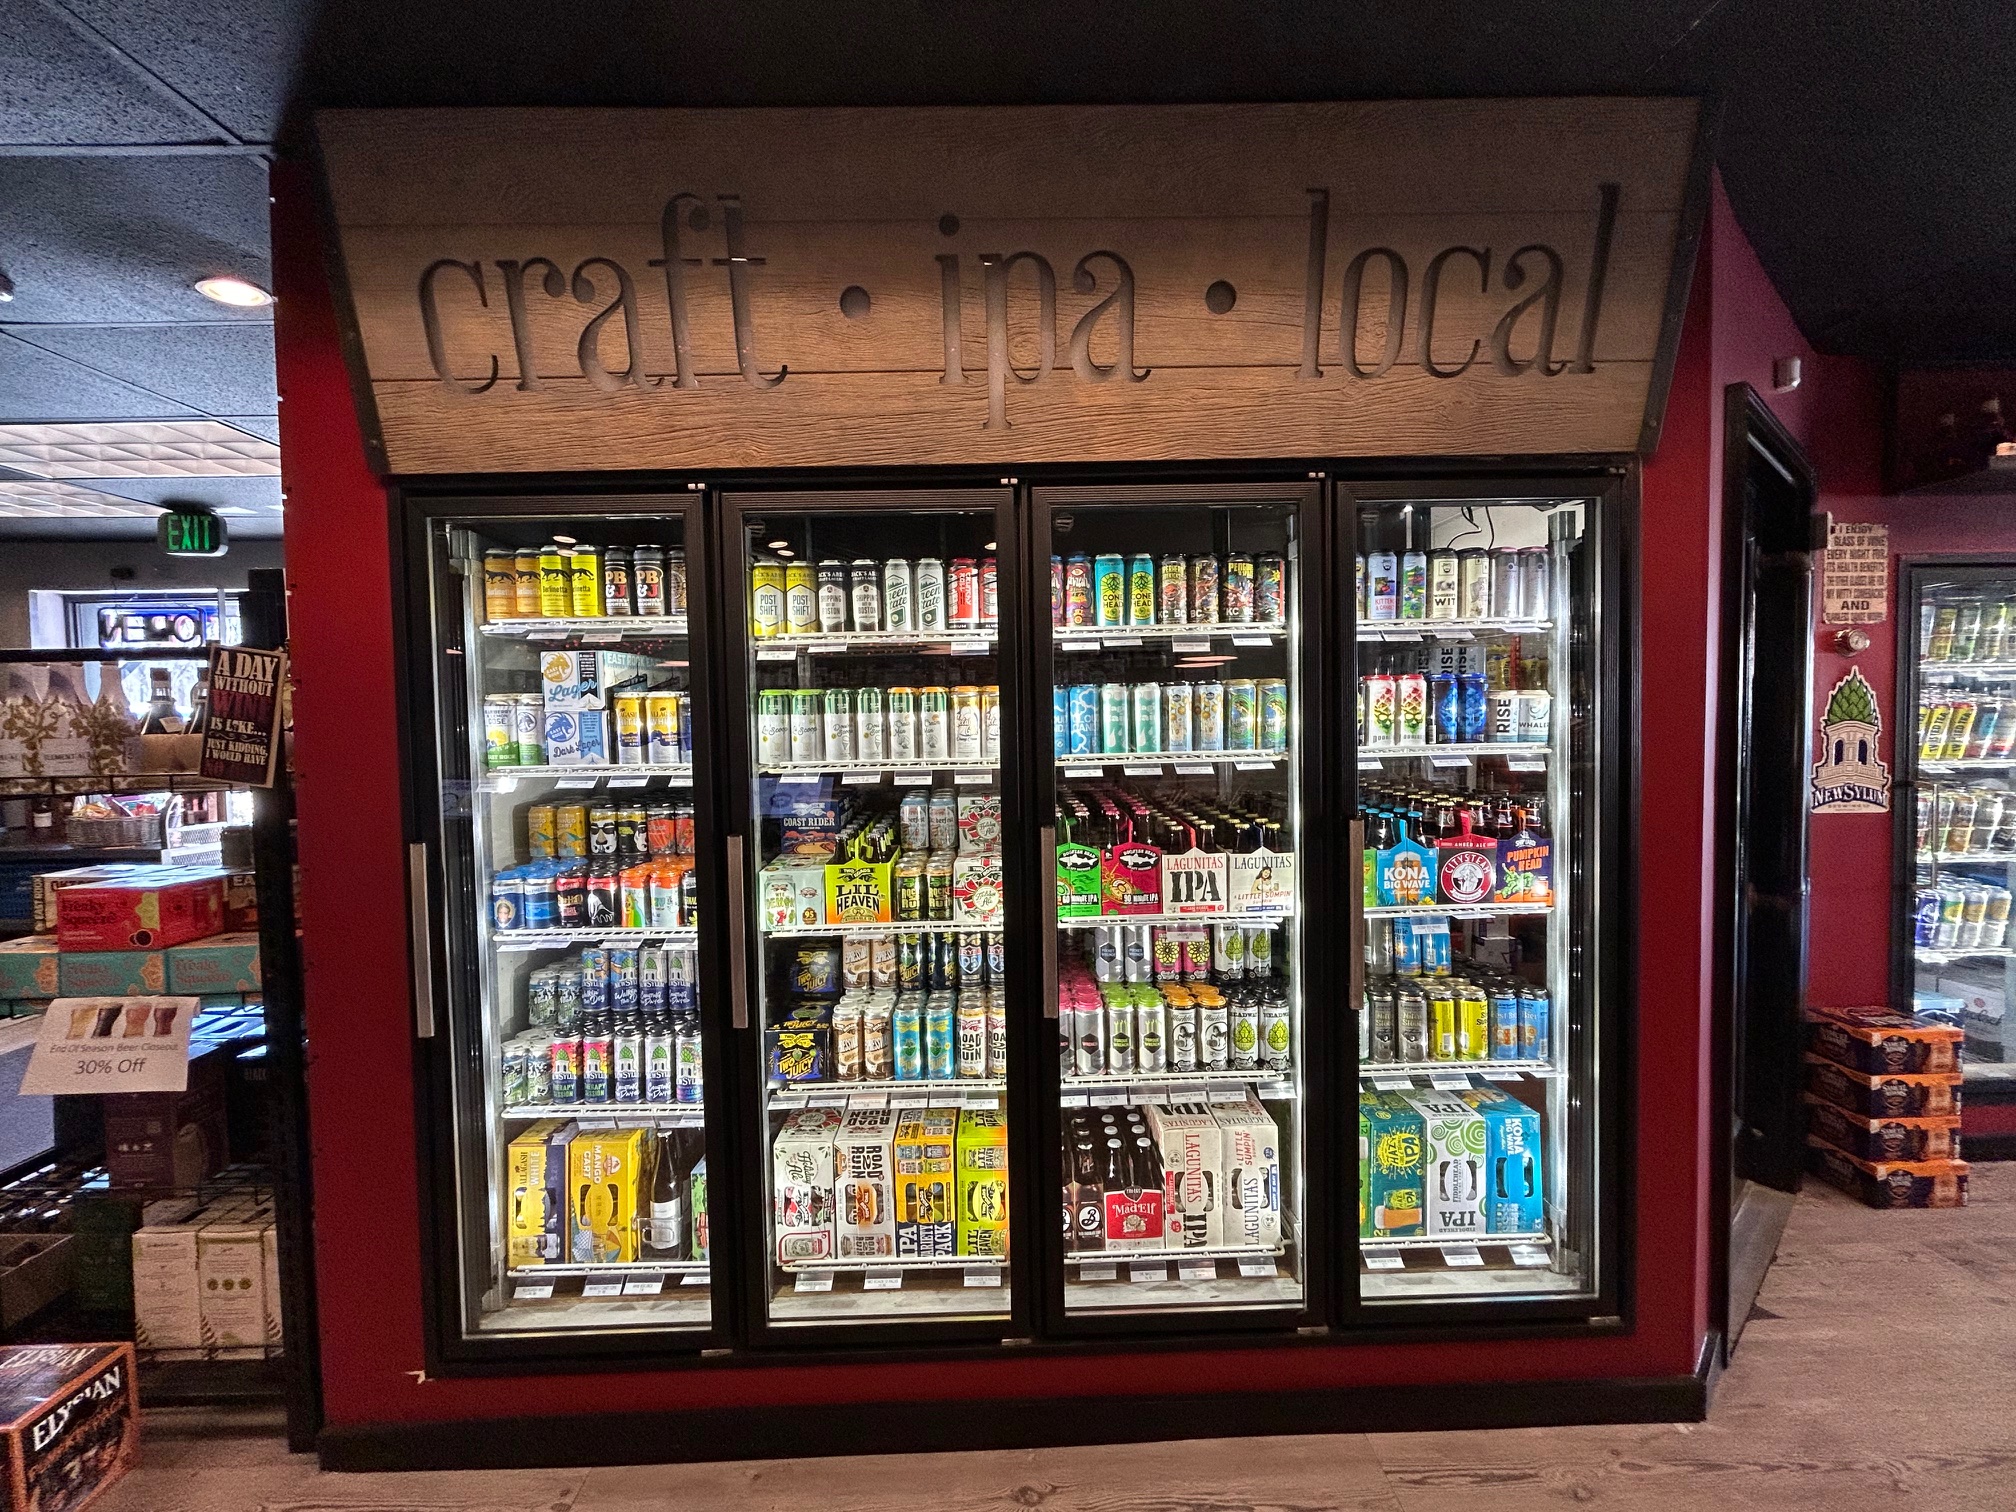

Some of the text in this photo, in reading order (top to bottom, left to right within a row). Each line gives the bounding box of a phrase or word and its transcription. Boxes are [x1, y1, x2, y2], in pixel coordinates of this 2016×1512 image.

[418, 183, 1622, 432] craft ipa local
[168, 516, 212, 551] EXIT
[605, 571, 626, 584] PB
[636, 571, 659, 584] PB
[606, 584, 626, 598] &J
[637, 584, 659, 598] &J
[760, 595, 776, 605] POST
[792, 595, 808, 605] POST
[1434, 598, 1455, 606] WIT
[1841, 600, 1870, 610] AND
[760, 606, 777, 615] SHIFT
[792, 606, 809, 615] SHIFT
[1226, 608, 1239, 616] KC
[215, 650, 278, 682] A DAY
[607, 653, 626, 665] EAST
[214, 675, 274, 696] WITHOUT
[548, 678, 598, 702] Lager
[211, 717, 223, 730] IS
[1496, 698, 1511, 733] RISE
[207, 738, 268, 756] JUST KIDDING,
[553, 739, 601, 757] Dark Lager
[212, 750, 242, 762] WOULD
[244, 753, 266, 766] HAVE
[783, 817, 835, 827] COAST RIDER
[1506, 846, 1549, 862] PUMPKIN
[1166, 856, 1224, 870] LAGUNITAS
[1234, 856, 1292, 870] LAGUNITAS
[1518, 858, 1542, 871] HEAD
[1384, 867, 1430, 880] KONA
[835, 884, 879, 896] LIL'
[1170, 870, 1221, 902] IPA
[1383, 880, 1431, 890] BIG WAVE
[836, 895, 880, 916] HEAVEN
[1088, 894, 1097, 902] IPA
[1124, 894, 1159, 903] 90 IPA
[960, 947, 981, 955] RYE
[962, 955, 978, 970] 95
[901, 964, 920, 981] JUICY
[797, 972, 828, 991] TWO JUICY
[590, 994, 605, 1005] Dog
[792, 1019, 818, 1028] JUICY
[50, 1044, 66, 1053] End
[79, 1044, 114, 1053] Season
[116, 1043, 138, 1051] Beer
[75, 1058, 147, 1075] 30% Off
[778, 1057, 814, 1079] TWO JUICY
[1422, 1103, 1470, 1113] IPA
[901, 1110, 912, 1124] IPA
[1218, 1117, 1272, 1125] LAGUNITAS
[1512, 1118, 1524, 1154] KONA
[1387, 1137, 1399, 1165] HAZY
[1403, 1136, 1418, 1165] IPA
[1507, 1135, 1515, 1155] WAVE
[519, 1151, 528, 1186] ALLAGASH
[530, 1151, 540, 1186] WHITE
[583, 1151, 591, 1179] CART
[593, 1145, 601, 1184] MANGO
[797, 1151, 814, 1184] Holiday
[852, 1146, 866, 1178] RUIN
[862, 1155, 871, 1169] 2
[866, 1146, 882, 1179] ROAD
[1185, 1133, 1201, 1203] LAGUNITAS
[786, 1161, 803, 1181] Ale
[1112, 1202, 1155, 1218] Mad Elf
[1244, 1177, 1259, 1245] LAGUNITAS
[1439, 1211, 1476, 1226] IPA
[1184, 1213, 1207, 1248] IPA
[899, 1224, 918, 1258] IPA
[33, 1366, 120, 1452] ELYSIAN
